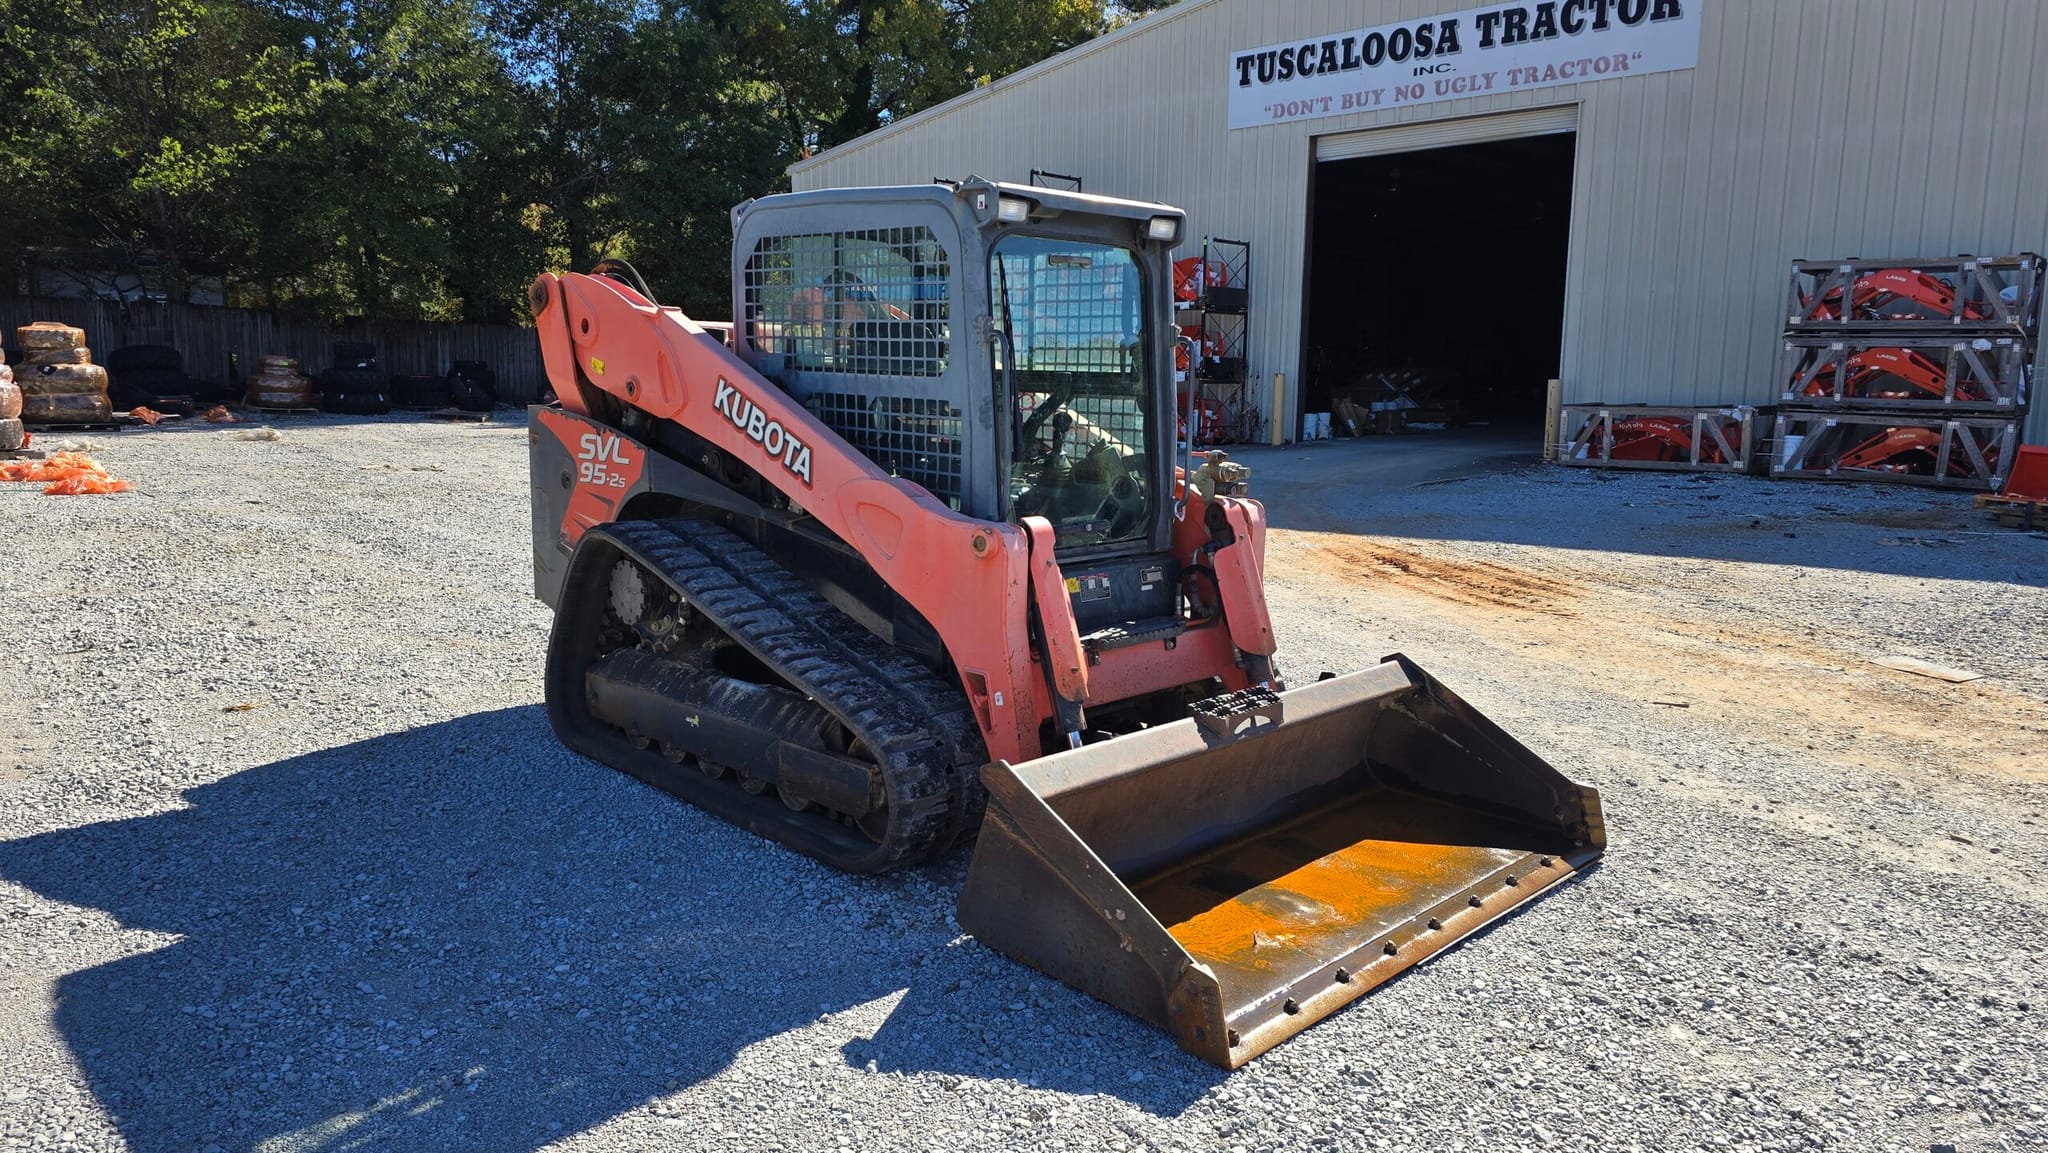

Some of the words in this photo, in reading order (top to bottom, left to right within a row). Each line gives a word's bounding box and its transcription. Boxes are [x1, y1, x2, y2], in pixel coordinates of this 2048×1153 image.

[1236, 18, 1461, 87] TUSCALOOSA
[1475, 0, 1683, 49] TRACTOR
[1413, 63, 1456, 77] INC.
[1340, 88, 1385, 110] BUY
[1394, 83, 1425, 102] NO
[1434, 72, 1498, 96] UGLY
[578, 433, 631, 465] SVL
[714, 378, 812, 484] KUBOTA
